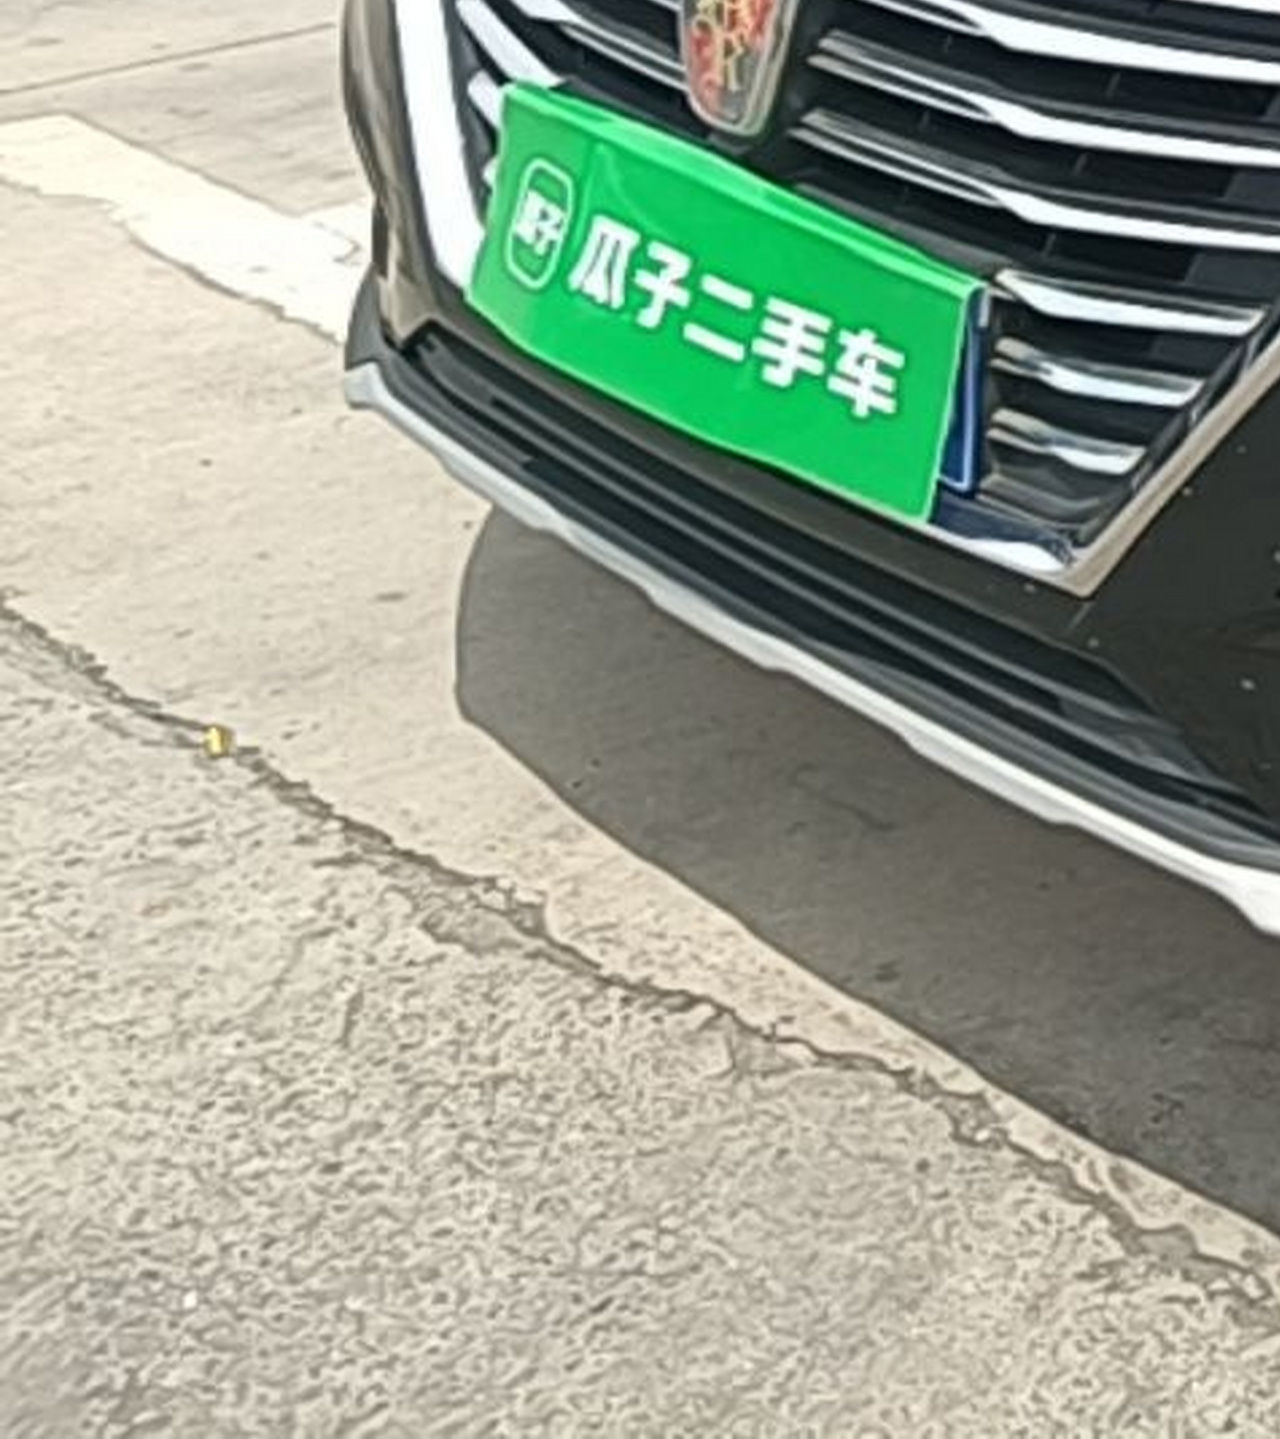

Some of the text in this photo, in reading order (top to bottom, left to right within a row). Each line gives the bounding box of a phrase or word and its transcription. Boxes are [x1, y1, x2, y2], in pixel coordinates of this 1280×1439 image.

[568, 217, 908, 421] 瓜子二手车
